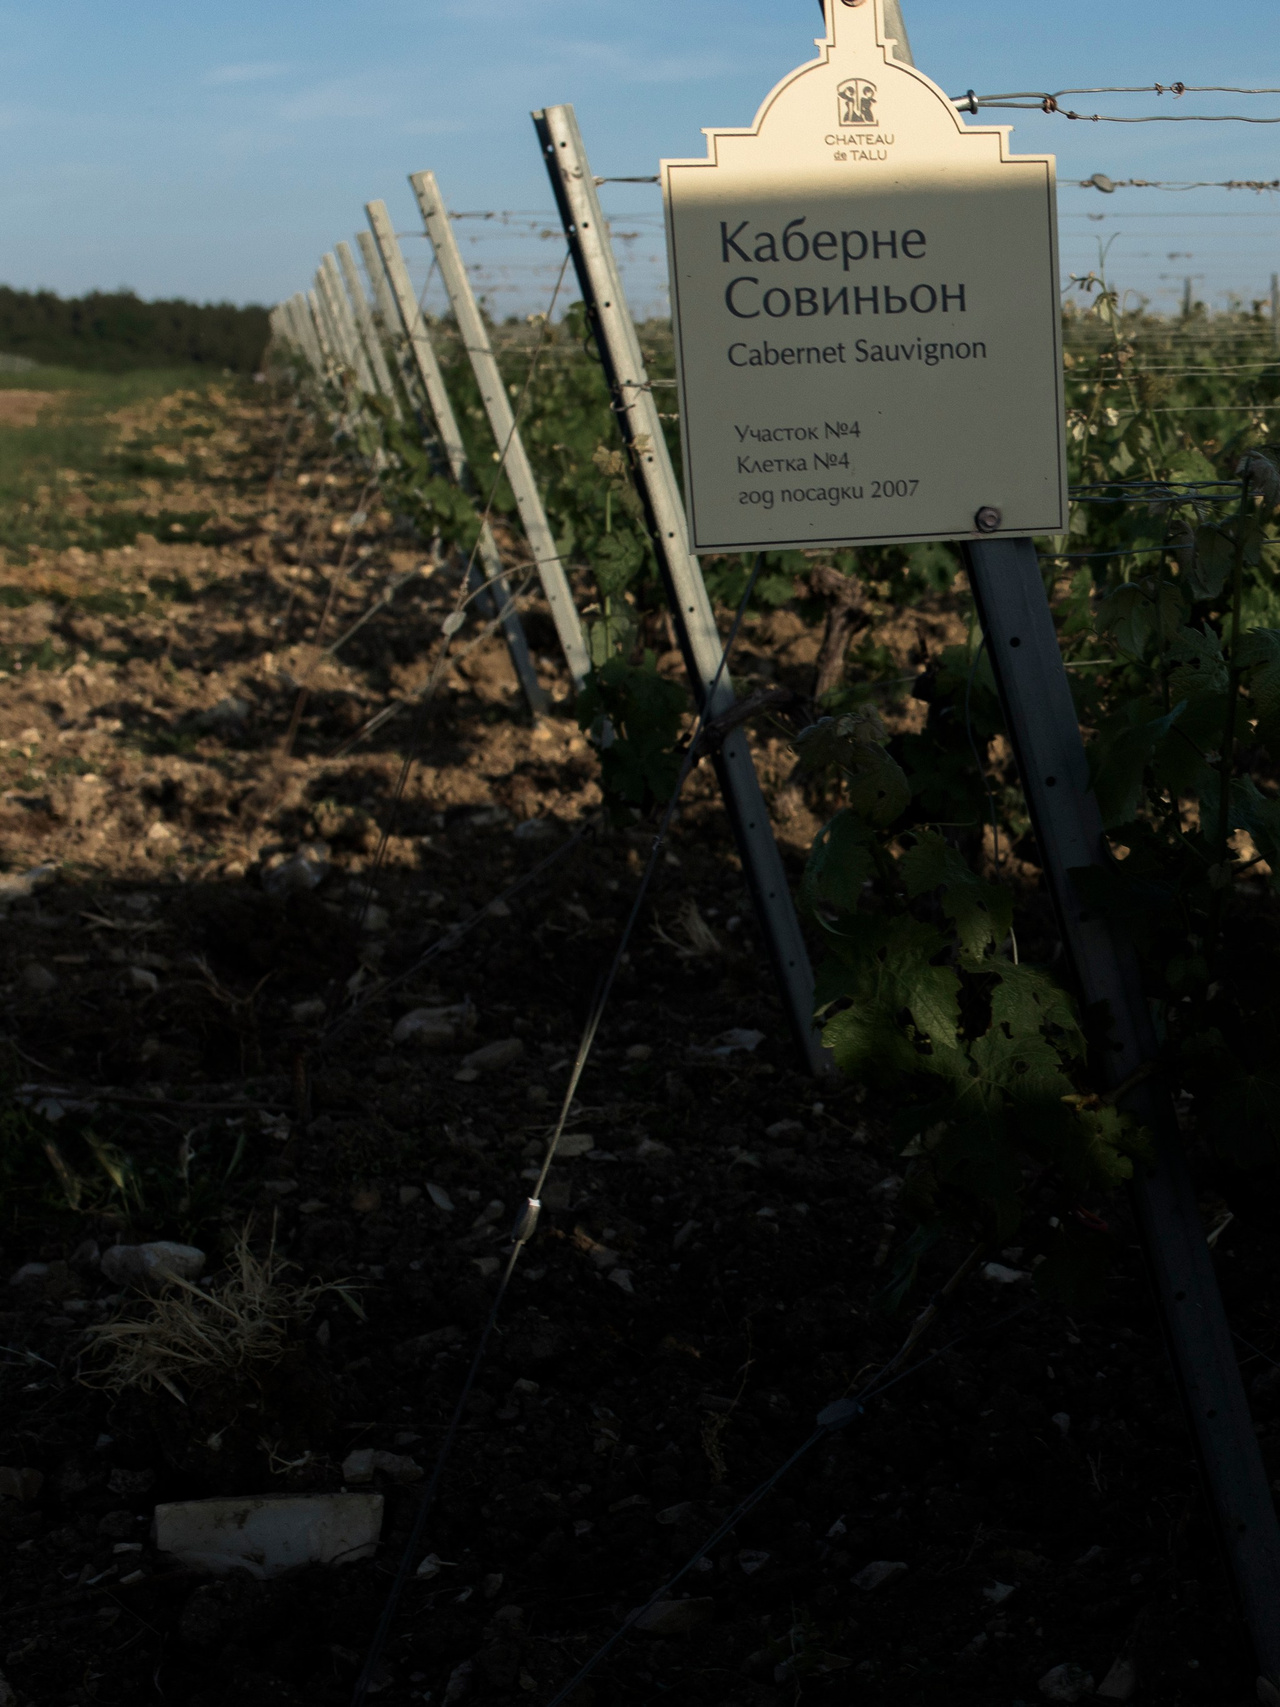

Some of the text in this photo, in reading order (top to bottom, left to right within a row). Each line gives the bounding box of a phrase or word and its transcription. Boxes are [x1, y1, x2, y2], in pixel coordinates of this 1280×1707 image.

[824, 134, 895, 146] CHATEAU
[834, 149, 888, 161] de TALU
[719, 215, 927, 272] Каберне
[724, 276, 967, 319] Совиньон
[728, 337, 987, 367] Cabernet Sauvignon
[734, 421, 861, 443] Участок №4
[737, 452, 850, 474] Клетка №4
[739, 479, 920, 509] год посадки 2007
